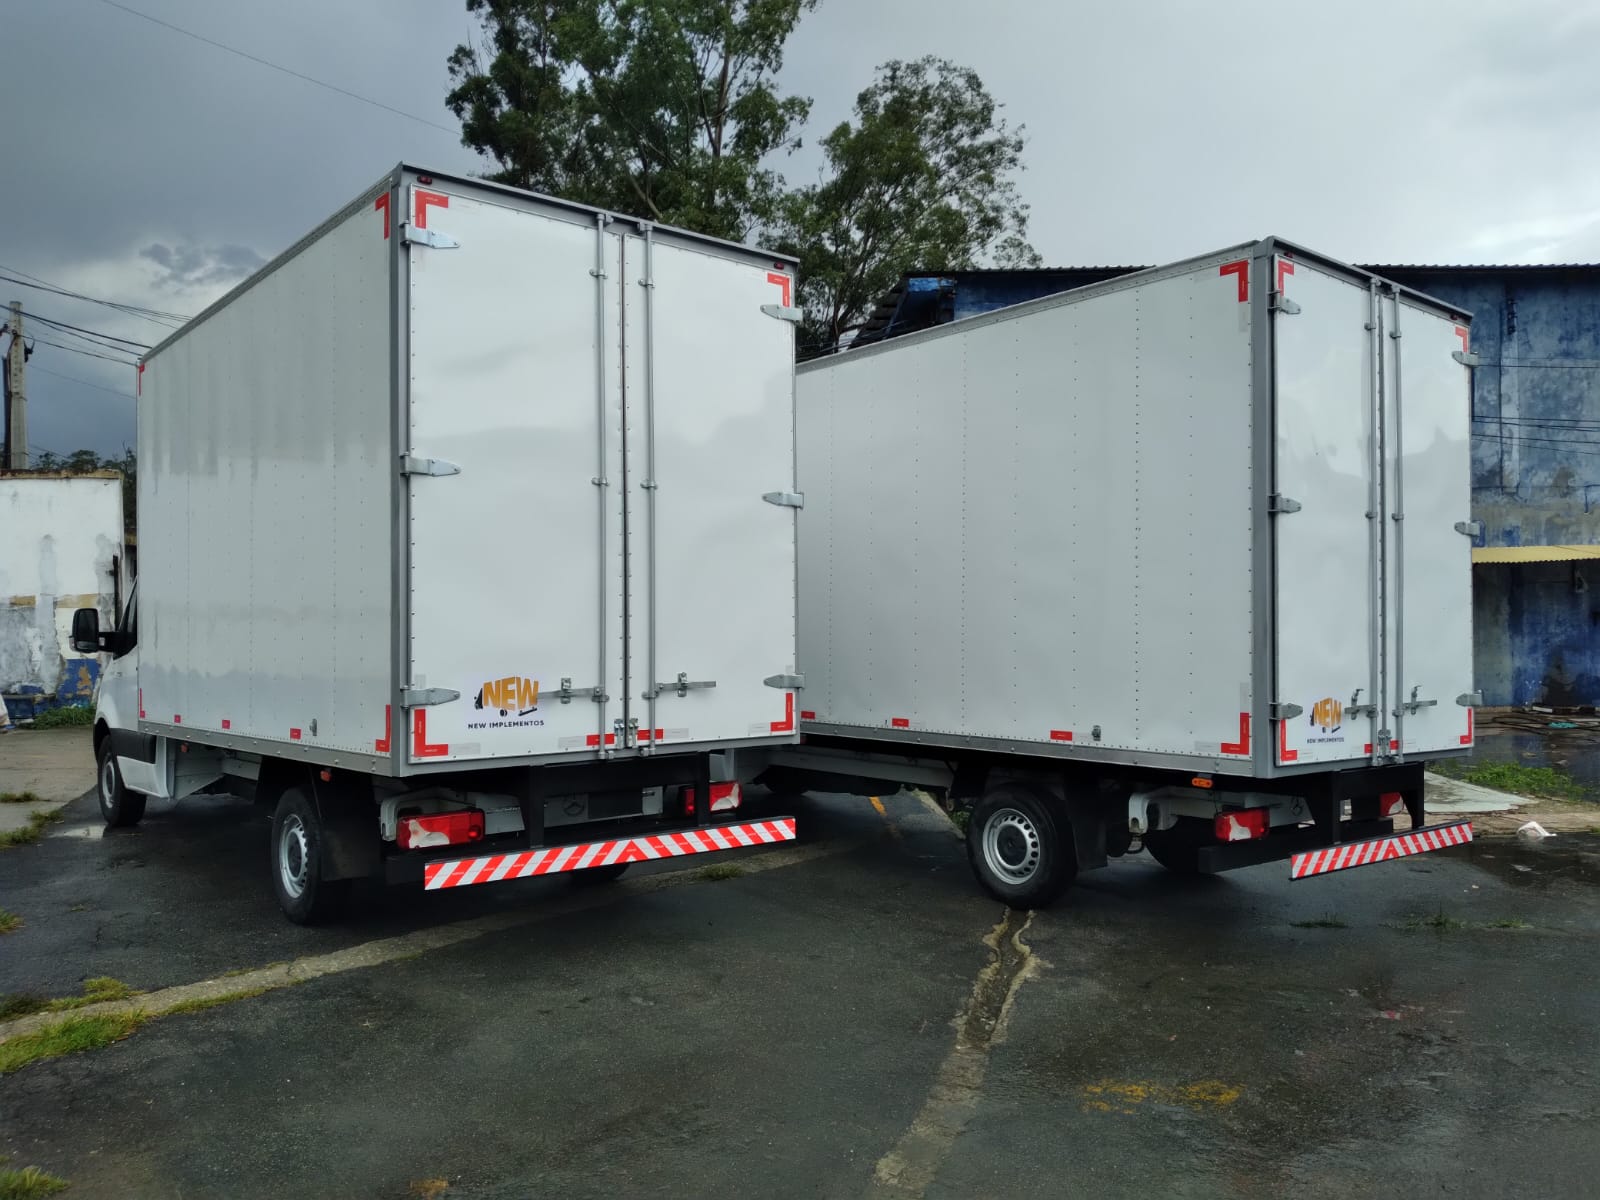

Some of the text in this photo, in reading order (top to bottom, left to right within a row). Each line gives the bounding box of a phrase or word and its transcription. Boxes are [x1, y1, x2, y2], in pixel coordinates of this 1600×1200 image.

[483, 676, 539, 711] NEW
[489, 720, 545, 728] IMPLEMENTOS
[1314, 697, 1342, 728] NEW
